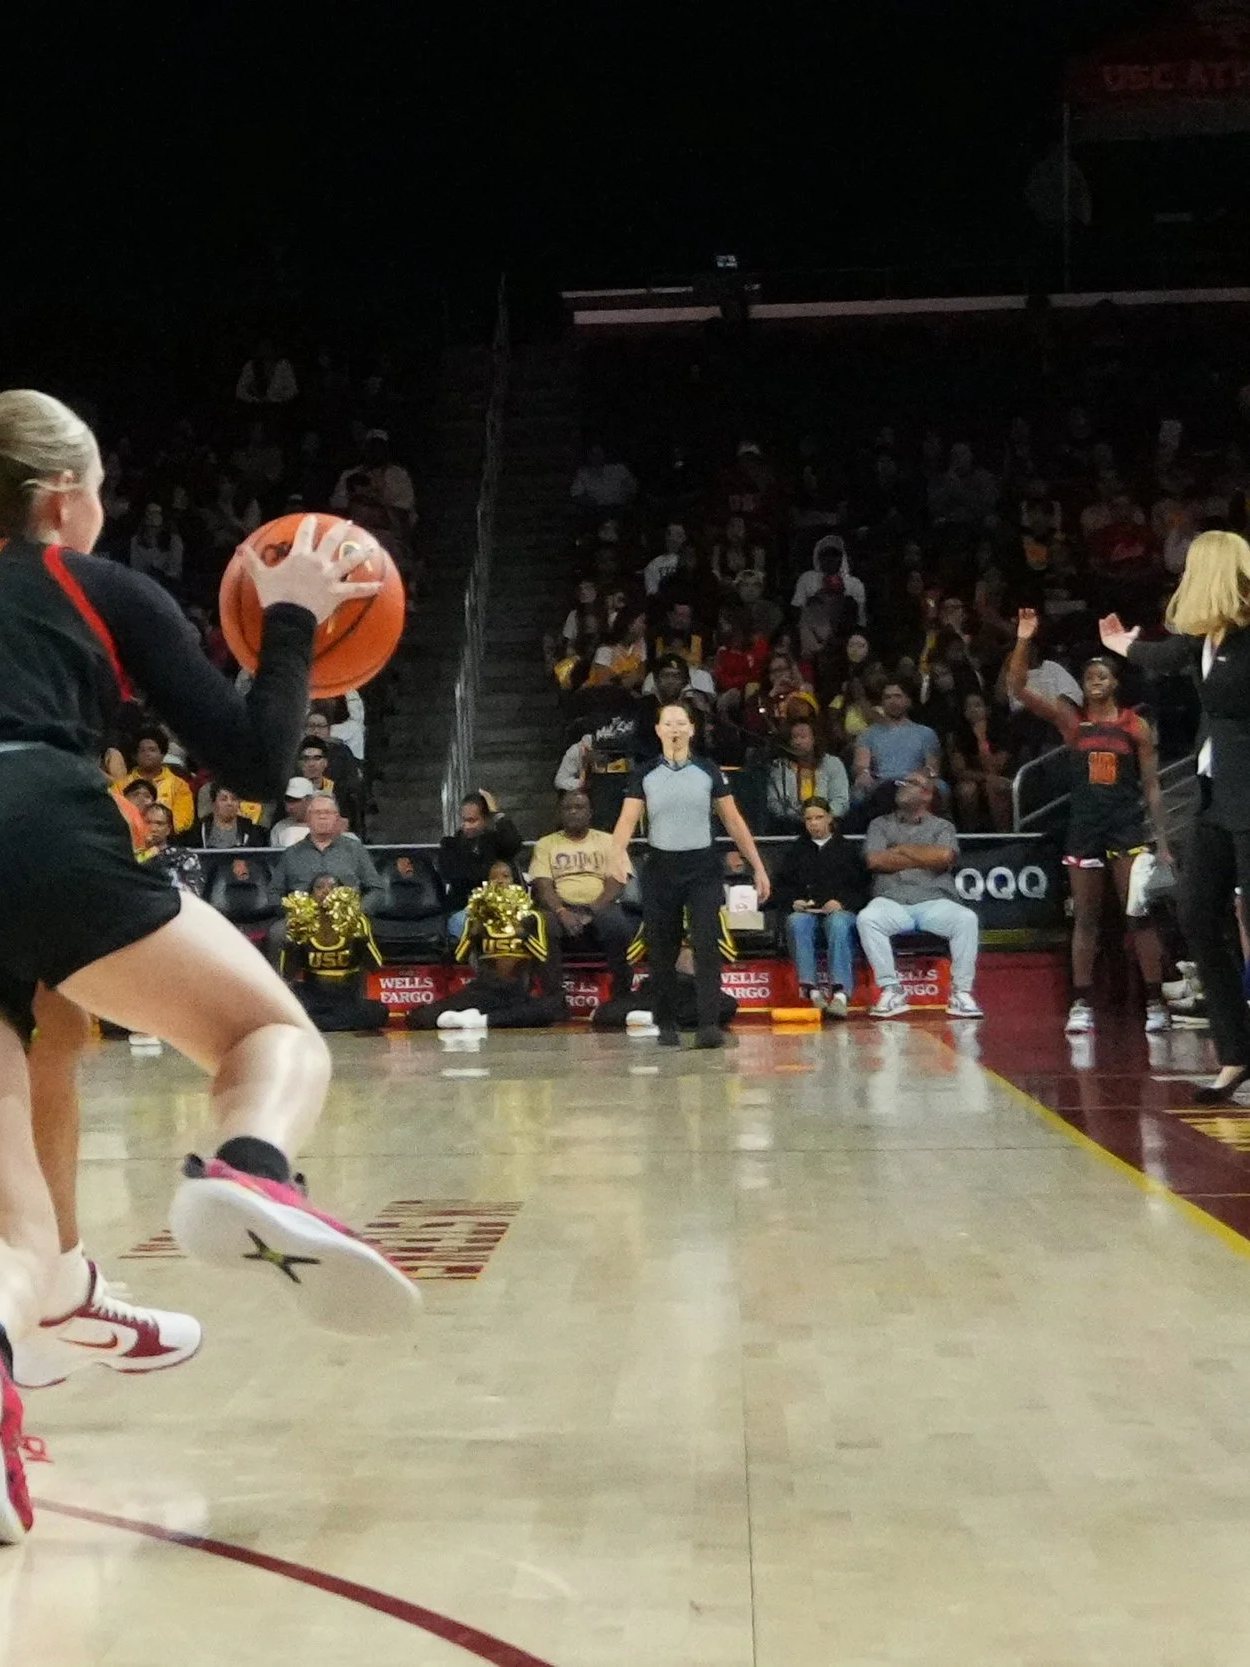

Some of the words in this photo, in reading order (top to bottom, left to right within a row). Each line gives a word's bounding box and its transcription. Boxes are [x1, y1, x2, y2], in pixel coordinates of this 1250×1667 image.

[954, 866, 1047, 901] QQQ
[308, 949, 350, 968] USC
[895, 969, 938, 981] ELLS
[379, 977, 434, 990] WELLS
[380, 991, 434, 1005] FARGO
[565, 995, 599, 1007] RGO
